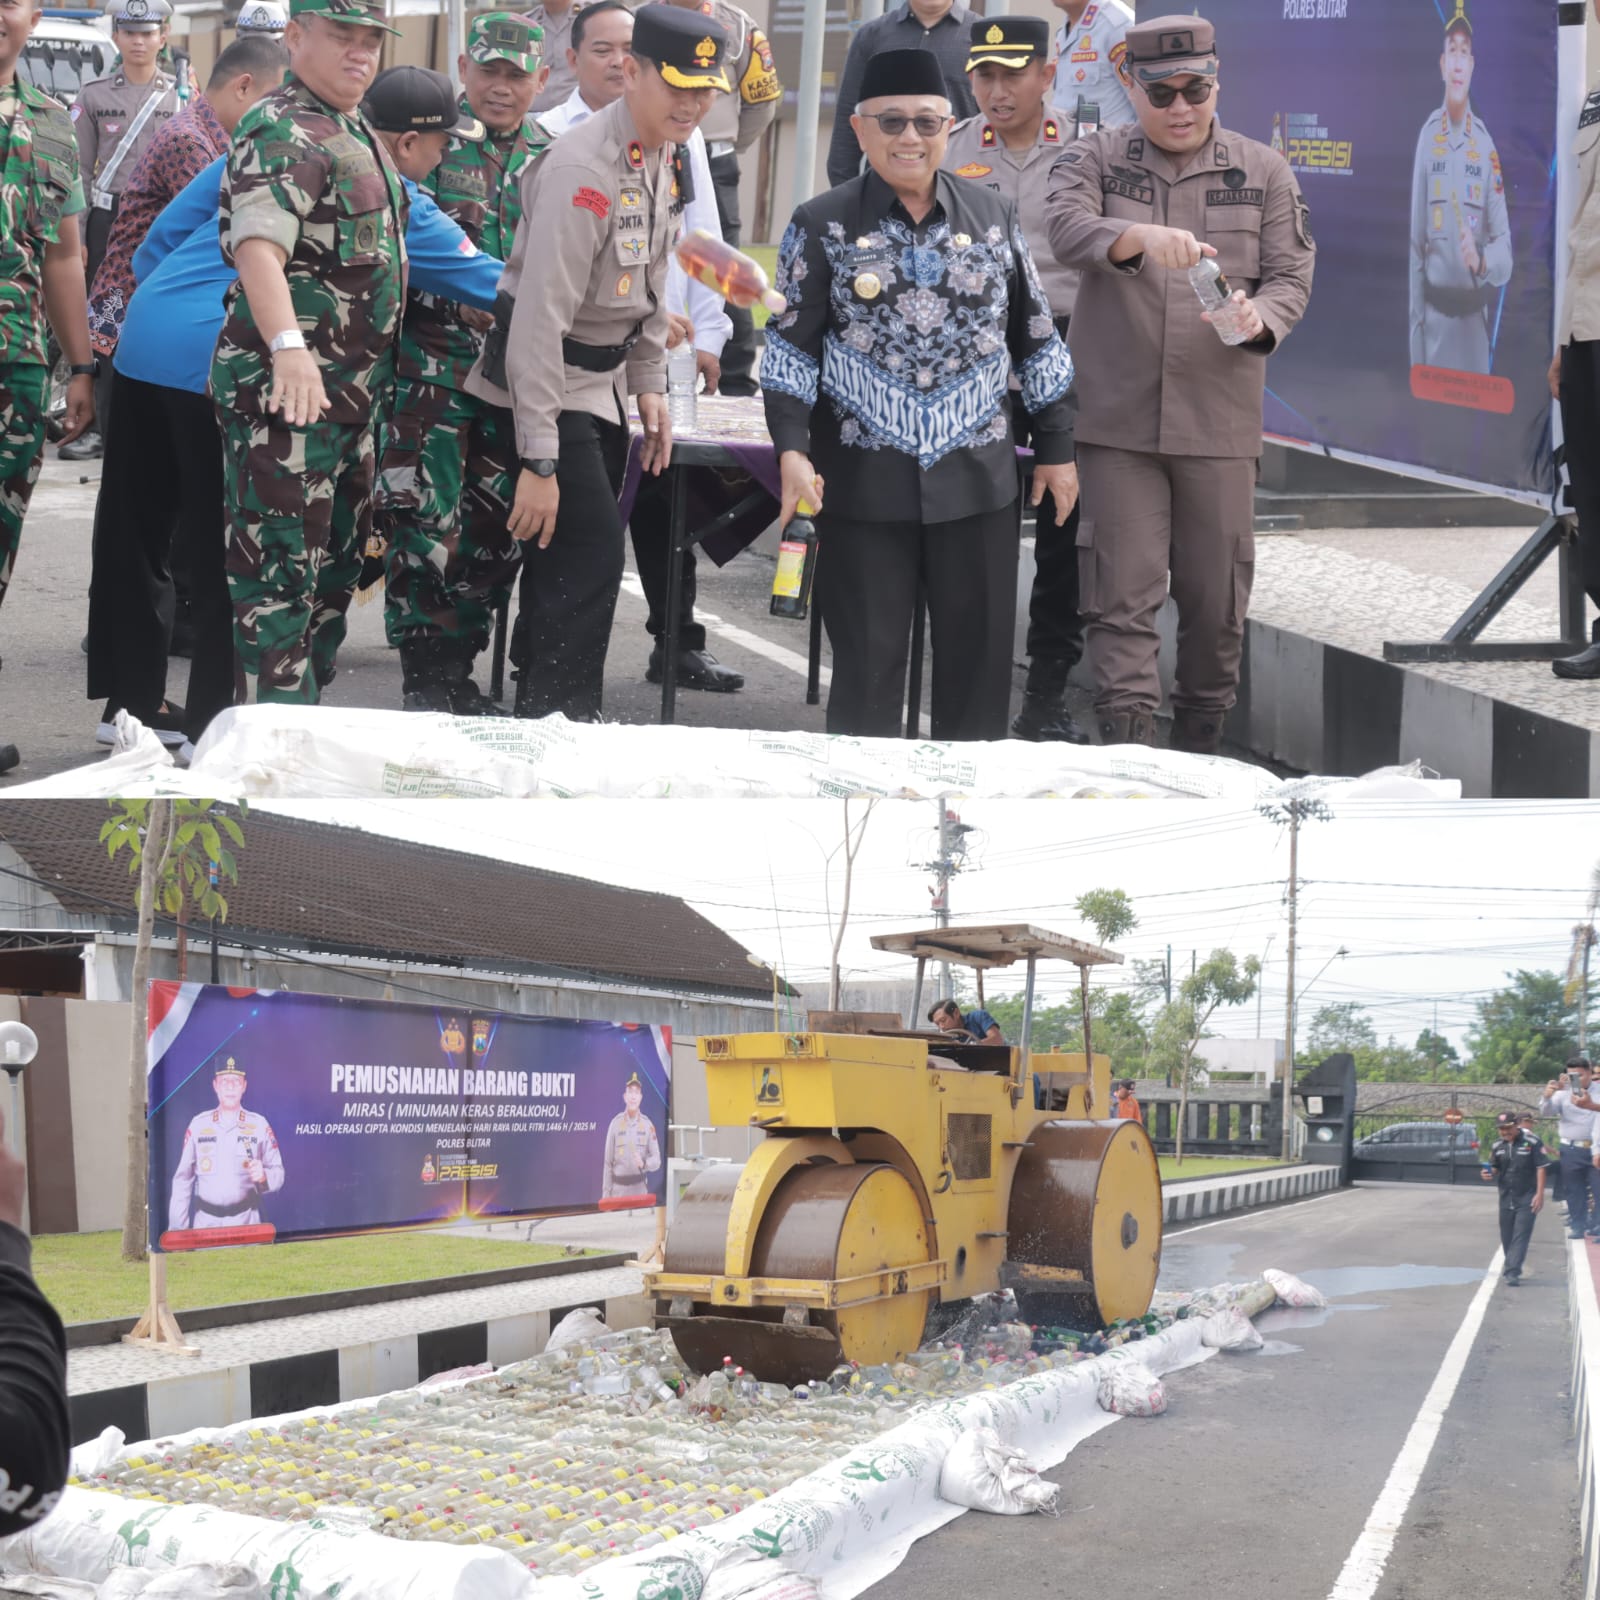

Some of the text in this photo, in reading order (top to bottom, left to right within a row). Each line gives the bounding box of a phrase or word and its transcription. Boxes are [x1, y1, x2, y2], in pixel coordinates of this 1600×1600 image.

[1283, 0, 1347, 19] POLRES BLITAR
[1287, 139, 1353, 168] PRESISI
[1107, 179, 1147, 201] OBET
[1209, 191, 1262, 205] KEJAKSAAN
[618, 214, 643, 230] OKTA
[331, 1063, 576, 1097] PEMUSNAHAN BARANG BUKTI
[343, 1102, 386, 1118] MIRAS
[395, 1103, 459, 1118] MINUMAN
[460, 1103, 495, 1118] KERAS
[497, 1104, 560, 1118] BERALKOHOL
[296, 1123, 323, 1135] HASIL
[324, 1123, 362, 1135] OPERASI
[364, 1123, 388, 1134] CIPTA
[390, 1123, 424, 1134] KONDISI
[425, 1122, 472, 1133] MENJELANG
[473, 1122, 492, 1133] HARI
[492, 1122, 510, 1133] RAYA
[511, 1122, 527, 1133] IDUL
[528, 1121, 545, 1132] FITRI
[546, 1121, 562, 1132] 1446
[573, 1121, 589, 1132] 2025
[589, 1121, 597, 1131] M
[436, 1137, 491, 1149] POLRES BLITAR
[439, 1164, 498, 1178] PRESISI
